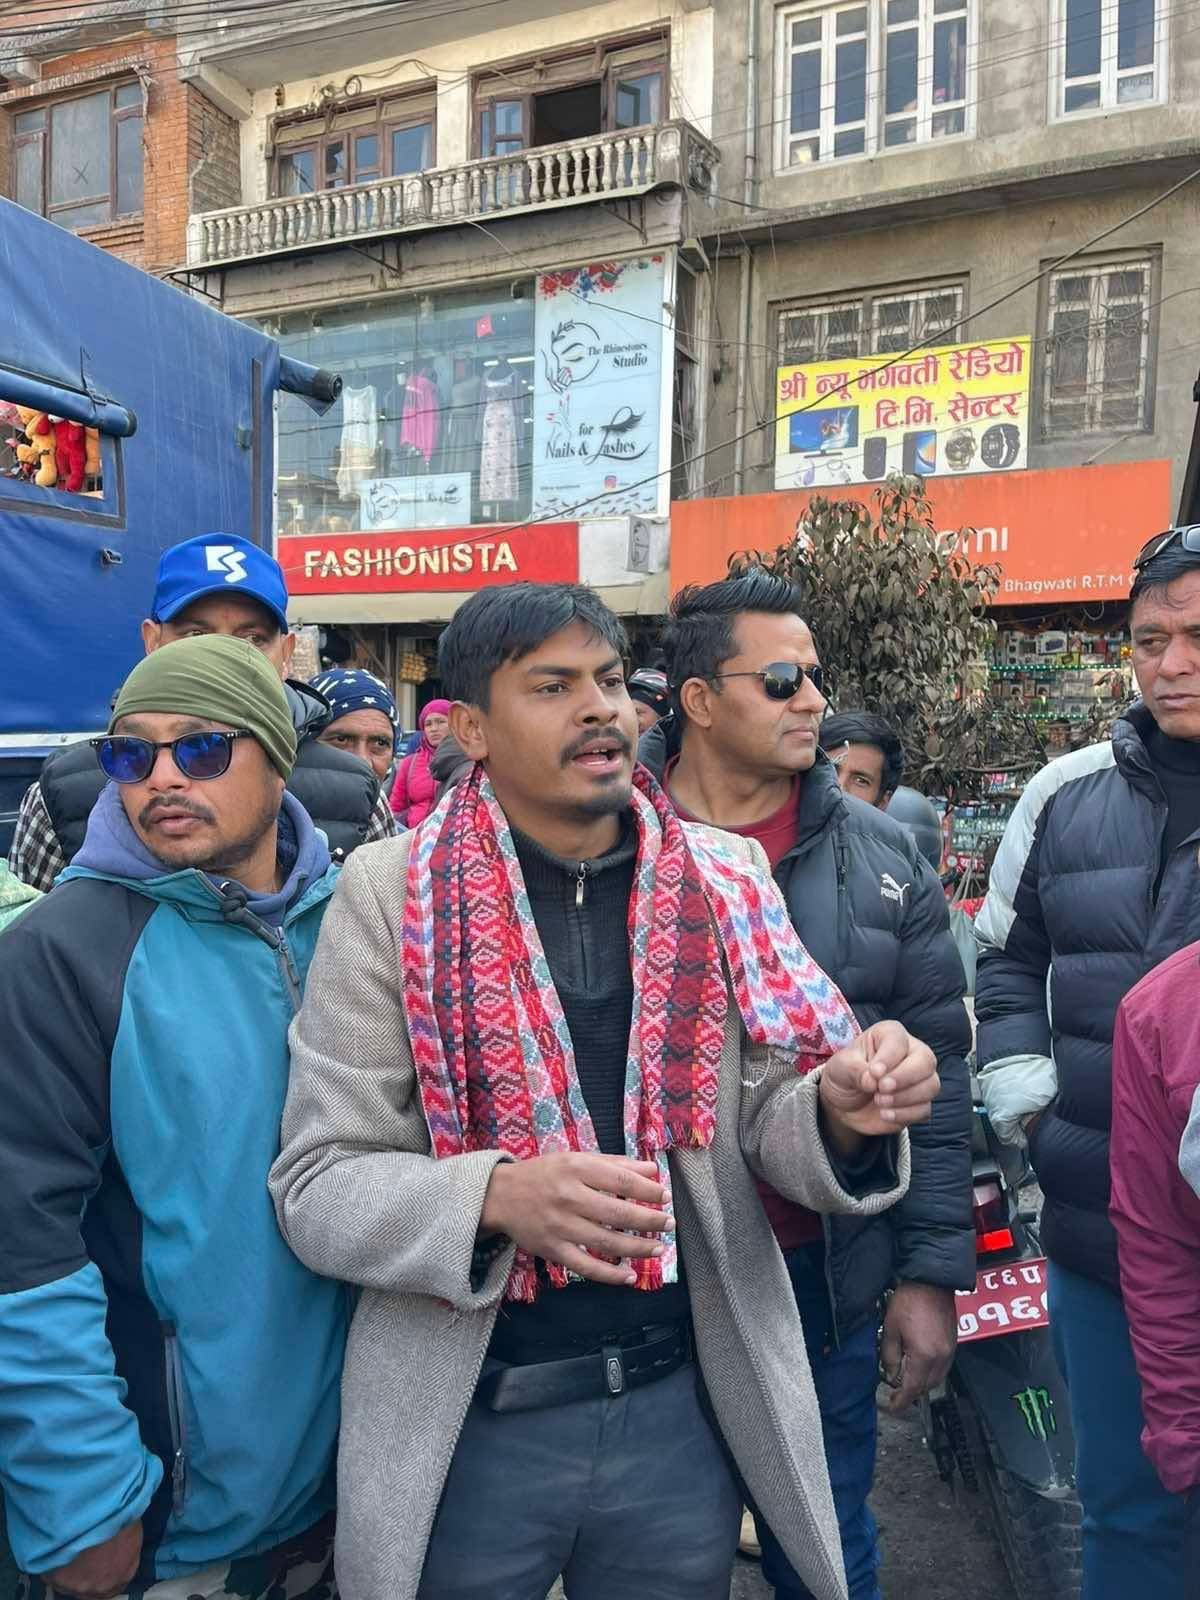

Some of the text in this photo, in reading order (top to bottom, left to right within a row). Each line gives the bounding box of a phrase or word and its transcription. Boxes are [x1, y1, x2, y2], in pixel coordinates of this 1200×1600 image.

[613, 352, 648, 368] Studio
[781, 371, 808, 401] श्री
[949, 342, 1025, 381] रेडियो
[948, 391, 1023, 423] सेन्टर
[579, 423, 594, 437] for
[545, 441, 576, 459] Nails
[578, 441, 589, 456] &
[303, 542, 519, 579] FASHIONISTA
[1004, 575, 1077, 595] Bhagwati
